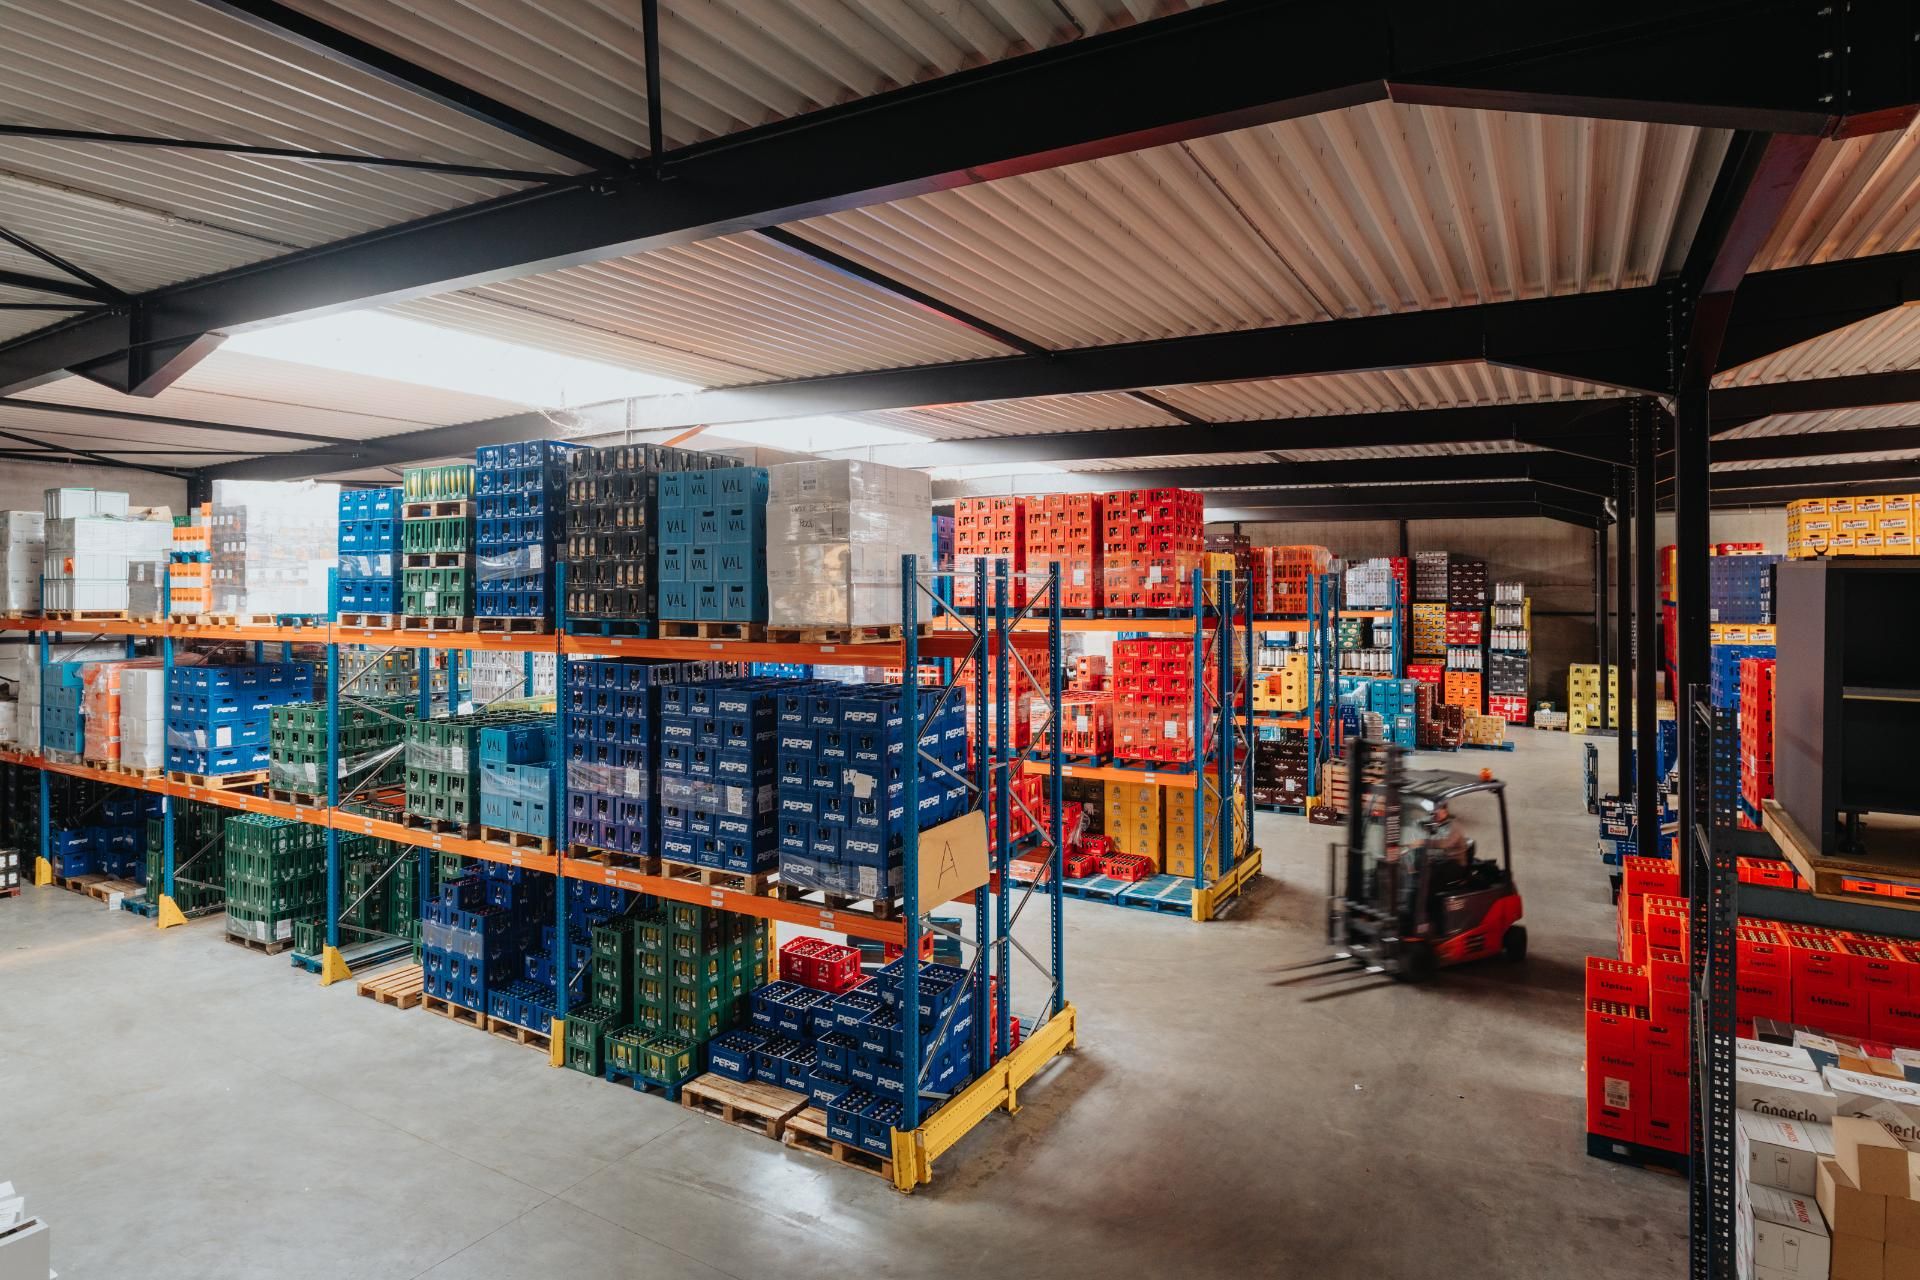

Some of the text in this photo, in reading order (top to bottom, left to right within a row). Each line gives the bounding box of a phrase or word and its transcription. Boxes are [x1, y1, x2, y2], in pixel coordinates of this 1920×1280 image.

[665, 486, 680, 497] VAL
[691, 484, 707, 495] VAL
[722, 480, 743, 493] VAL
[757, 482, 768, 492] VA
[667, 520, 687, 533] VAL
[701, 522, 717, 533] VAL
[728, 520, 746, 531] VAL
[665, 560, 680, 570] VAL
[692, 560, 708, 570] VAL
[722, 556, 743, 570] VAL
[667, 594, 687, 607] VAL
[701, 597, 717, 608] VAL
[728, 597, 746, 608] VAL
[718, 702, 747, 713] PEPSI
[952, 705, 965, 714] PEPSI
[782, 714, 802, 722] PEPSI
[844, 712, 877, 723] PEPSI
[887, 718, 903, 727] PEPSI
[665, 726, 692, 737] PEPSI
[946, 727, 965, 740] PEPSI
[728, 739, 747, 747] PEPSI
[782, 738, 812, 750] PEPSI
[918, 734, 939, 746] PEPSI
[487, 740, 502, 752] VAL
[888, 743, 904, 755] PEP
[824, 748, 844, 757] PEPSI
[856, 752, 877, 760] PEPSI
[217, 758, 238, 766] PEPSI
[665, 762, 682, 770] PEPSI
[719, 762, 747, 773] PEPSI
[692, 764, 709, 773] PEPSI
[932, 770, 946, 779] PEPS
[782, 776, 802, 785] PEPSI
[814, 780, 834, 788] PEPSI
[946, 786, 966, 800] PEPSI
[701, 796, 719, 804] PEPSI
[919, 795, 940, 810] PEPSI
[487, 802, 502, 816] VAL
[783, 800, 813, 812] PEPSI
[824, 814, 845, 822] PEPSI
[888, 807, 904, 820] PEP
[534, 814, 545, 825] VAL
[665, 820, 682, 828] PEPSI
[857, 817, 879, 826] PEPSI
[692, 824, 709, 832] PEPSI
[720, 820, 748, 833] PEPSI
[665, 842, 692, 854] PEPSI
[784, 838, 803, 847] PEPSI
[846, 840, 878, 853] PEPSI
[814, 844, 835, 853] PEPSI
[728, 860, 748, 868] PEPSI
[784, 863, 814, 876] PEPSI
[938, 840, 959, 890] A
[1601, 981, 1633, 992] Lipton
[1736, 984, 1773, 996] Lipton
[1811, 996, 1850, 1008] Lipton
[753, 1012, 771, 1022] PEPSI
[1889, 1008, 1920, 1019] Lipto
[780, 1021, 798, 1030] PEPSI
[815, 1018, 833, 1028] PEP
[837, 1014, 859, 1028] PEP
[954, 1014, 973, 1036] PEPSI
[863, 1042, 884, 1053] PEPSI
[1736, 1043, 1791, 1059] Tongerl
[713, 1056, 739, 1072] PEPSI
[821, 1061, 842, 1071] PEPSI
[1601, 1056, 1635, 1067] Lipton
[758, 1070, 776, 1080] PEPSI
[852, 1070, 873, 1080] PEPSI
[940, 1066, 954, 1082] PEPSI
[1741, 1066, 1808, 1085] Tongerlo
[786, 1078, 805, 1088] PEPSI
[877, 1077, 904, 1092] PEPS
[1847, 1077, 1918, 1097] Tongerlo
[814, 1090, 837, 1101] PEP
[832, 1127, 853, 1139] PEPSI
[864, 1138, 887, 1150] PEPSI
